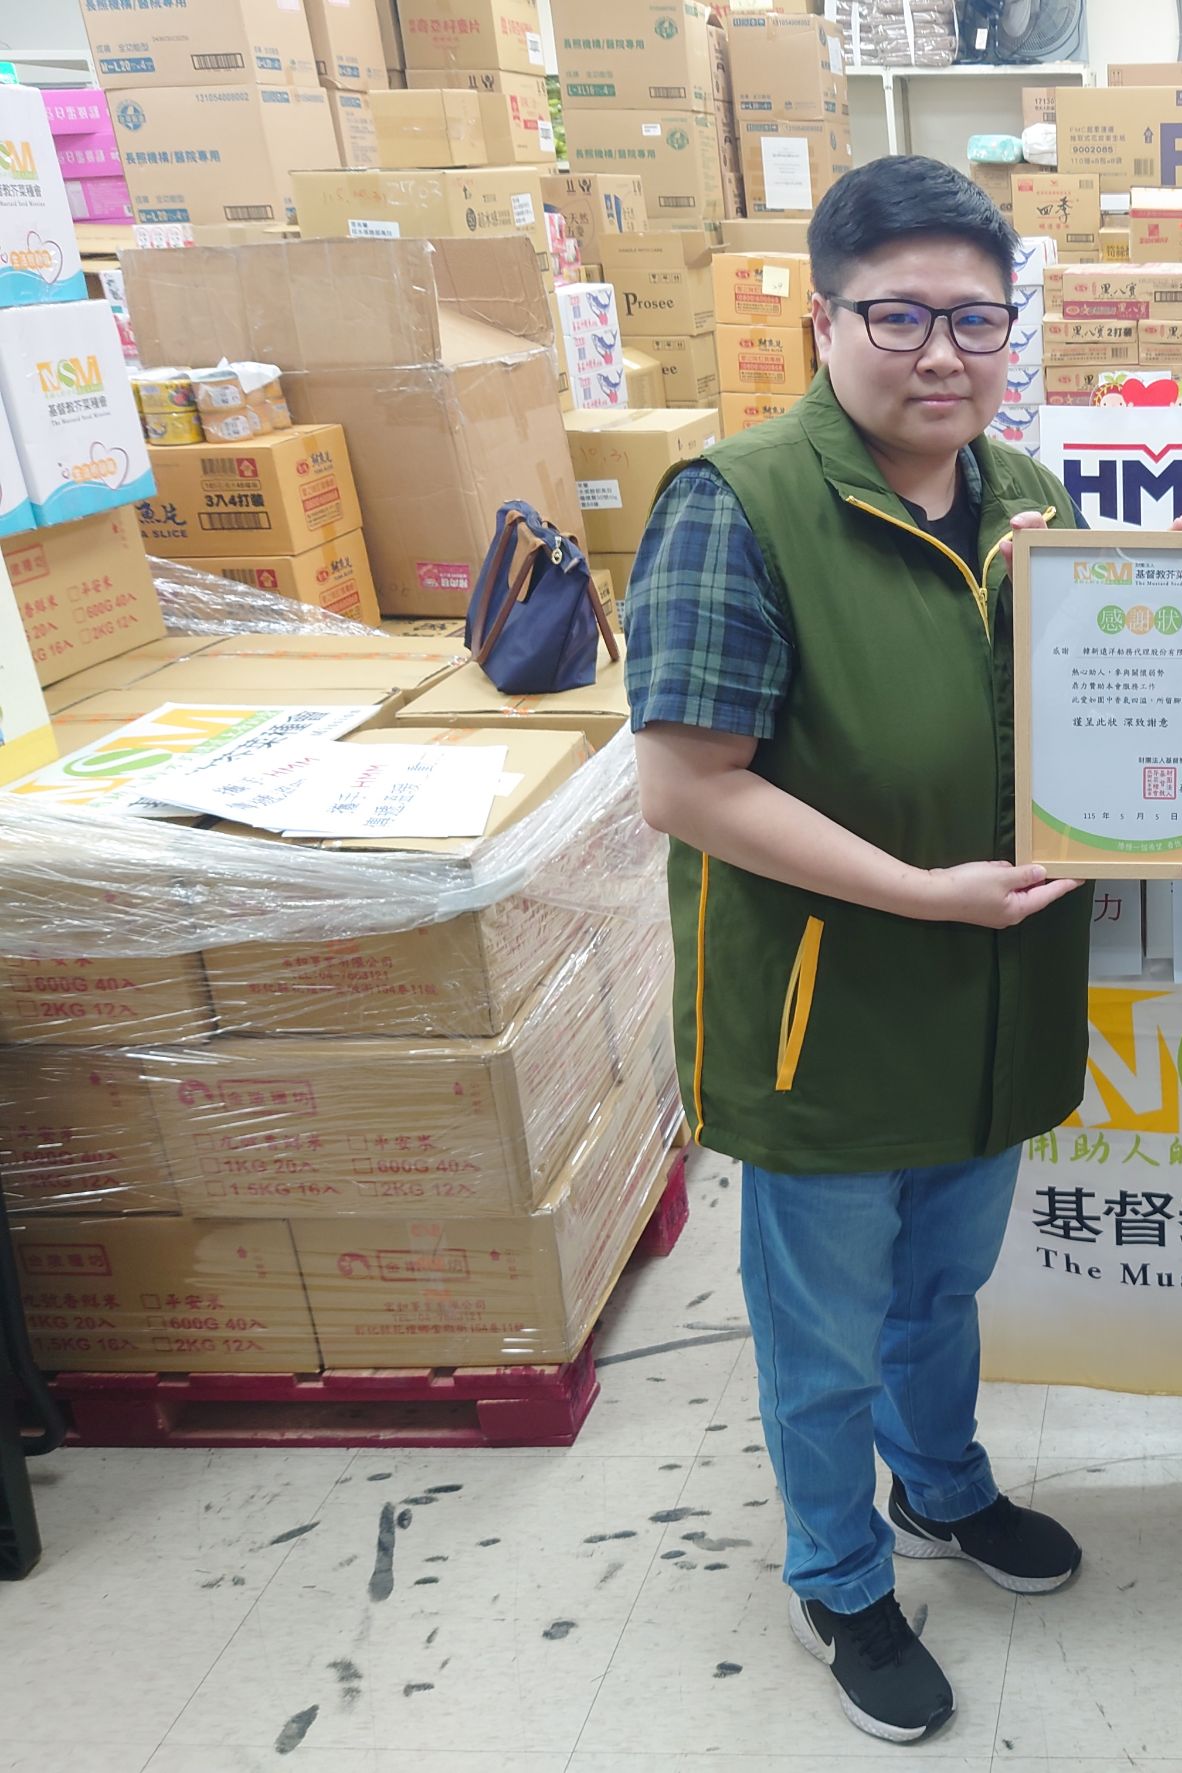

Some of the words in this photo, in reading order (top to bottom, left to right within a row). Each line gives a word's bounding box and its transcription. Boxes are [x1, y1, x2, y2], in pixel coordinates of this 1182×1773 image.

[624, 292, 674, 316] Prosee
[1107, 327, 1133, 337] 2打裝
[205, 494, 264, 508] 3入4打裝
[153, 530, 188, 538] SLICE
[1101, 608, 1180, 632] 感謝狀
[1123, 718, 1169, 728] 深致謝意
[1102, 812, 1110, 820] 年
[1137, 812, 1144, 820] 月
[1171, 813, 1178, 821] 日
[1094, 893, 1122, 922] 力
[36, 977, 88, 992] 600G
[41, 1002, 86, 1017] 2KG
[377, 1159, 429, 1174] 600G
[381, 1182, 424, 1197] 2KG
[1036, 1246, 1102, 1280] The
[165, 1294, 224, 1310] 平安米
[28, 1316, 68, 1330] 1KG
[75, 1316, 116, 1330] 20入
[170, 1316, 219, 1330] 600G
[225, 1316, 268, 1330] 40入
[175, 1338, 216, 1351] 2KG
[223, 1338, 266, 1351] 12入
